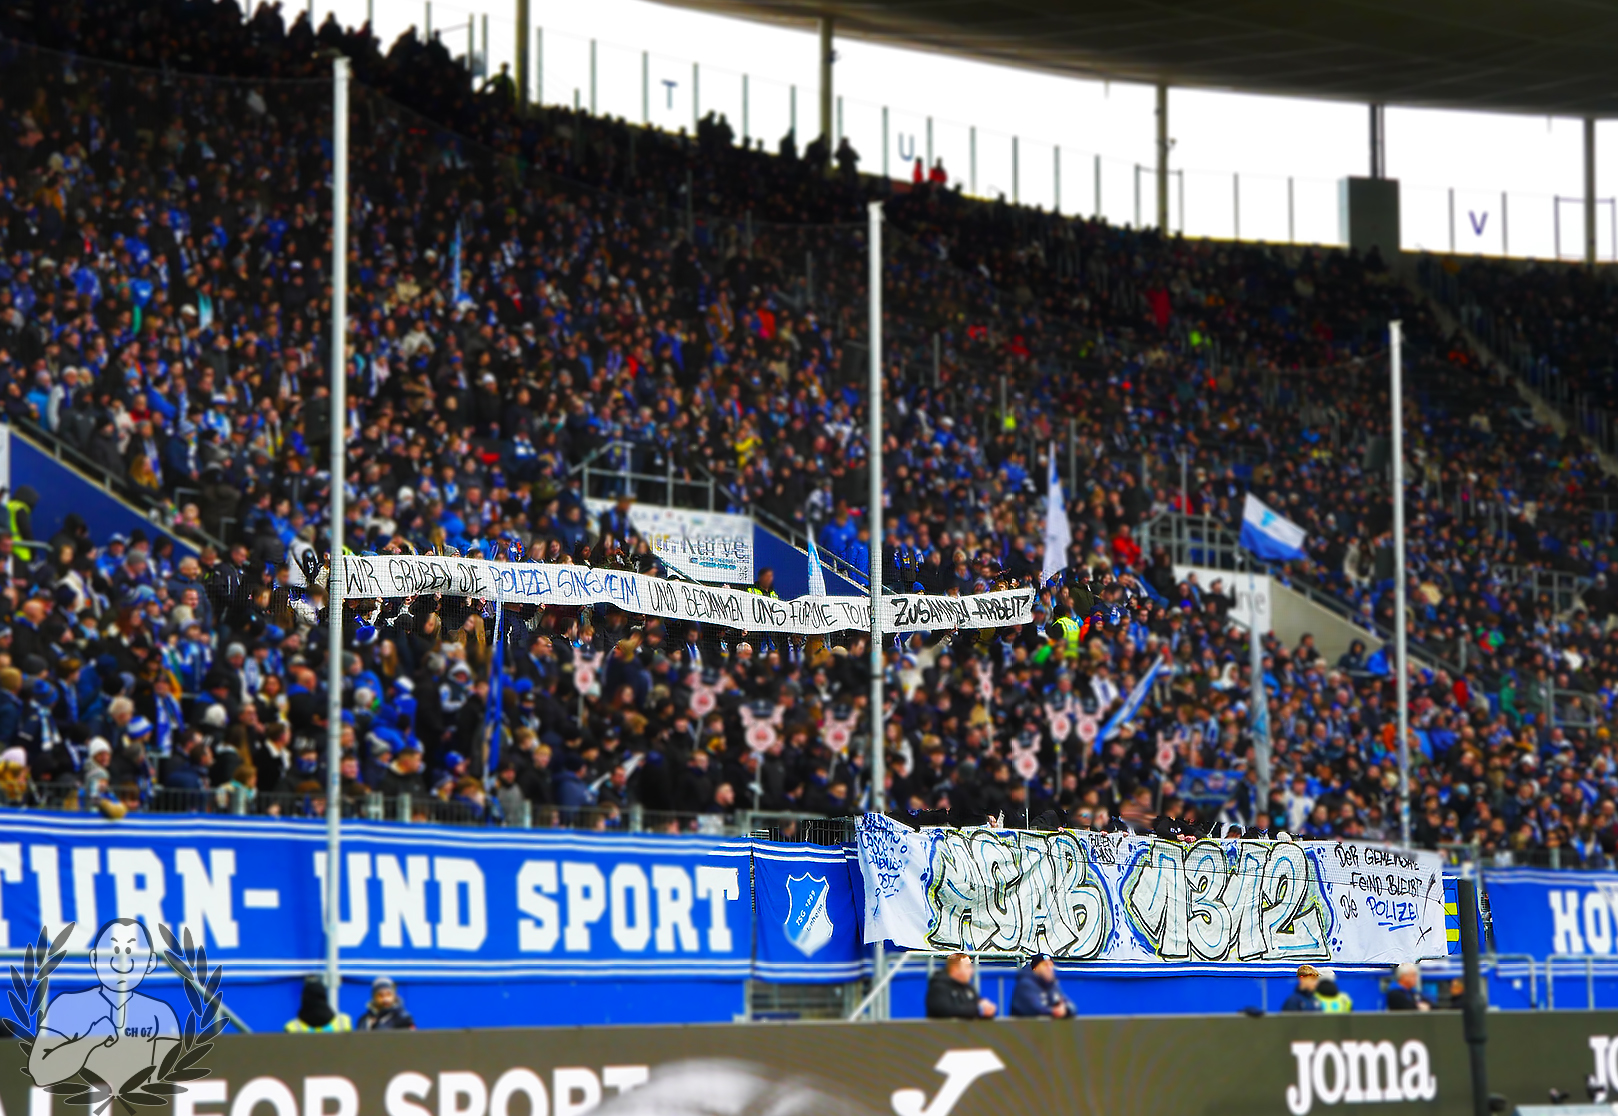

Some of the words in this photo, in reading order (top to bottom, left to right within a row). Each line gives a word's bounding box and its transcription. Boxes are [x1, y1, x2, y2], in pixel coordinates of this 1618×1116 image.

[343, 556, 384, 594] WIR
[456, 562, 487, 593] DIE
[488, 565, 552, 597] POLIZEI
[557, 568, 642, 608] SINSHEIM
[647, 580, 678, 614] UND
[681, 585, 745, 622] BEDANKEN
[752, 597, 787, 627] UNS
[0, 842, 280, 949] TURN-
[313, 851, 487, 952] UND
[516, 858, 740, 953] SPORT
[926, 828, 1106, 959] ACAB
[1129, 838, 1332, 961] 1312
[1548, 889, 1618, 954] HO
